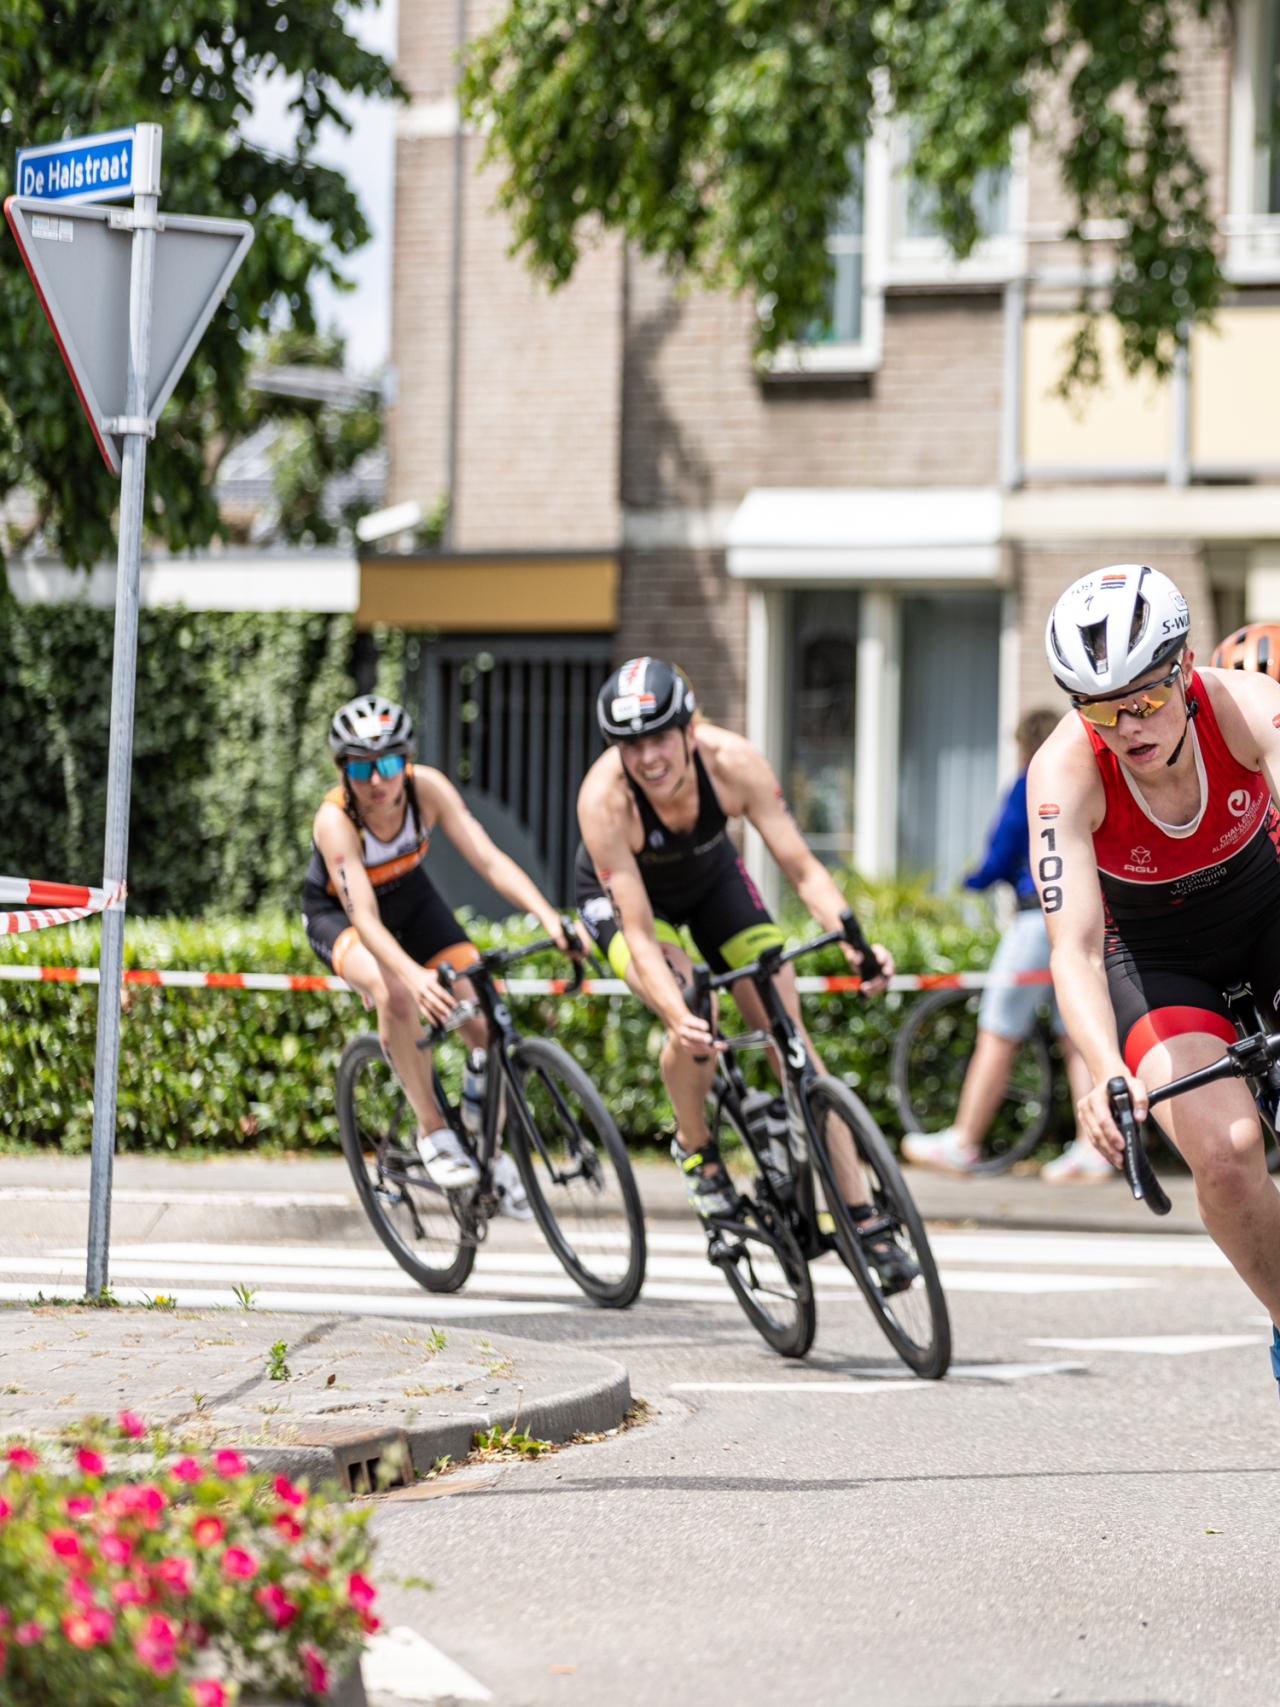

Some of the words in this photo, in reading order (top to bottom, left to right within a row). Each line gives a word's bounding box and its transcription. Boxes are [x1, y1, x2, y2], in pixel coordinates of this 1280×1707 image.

[24, 165, 44, 196] De
[48, 147, 129, 192] Halstraat
[1219, 800, 1257, 844] CHALLENGE
[1039, 828, 1063, 914] 109
[1123, 863, 1158, 874] AGU
